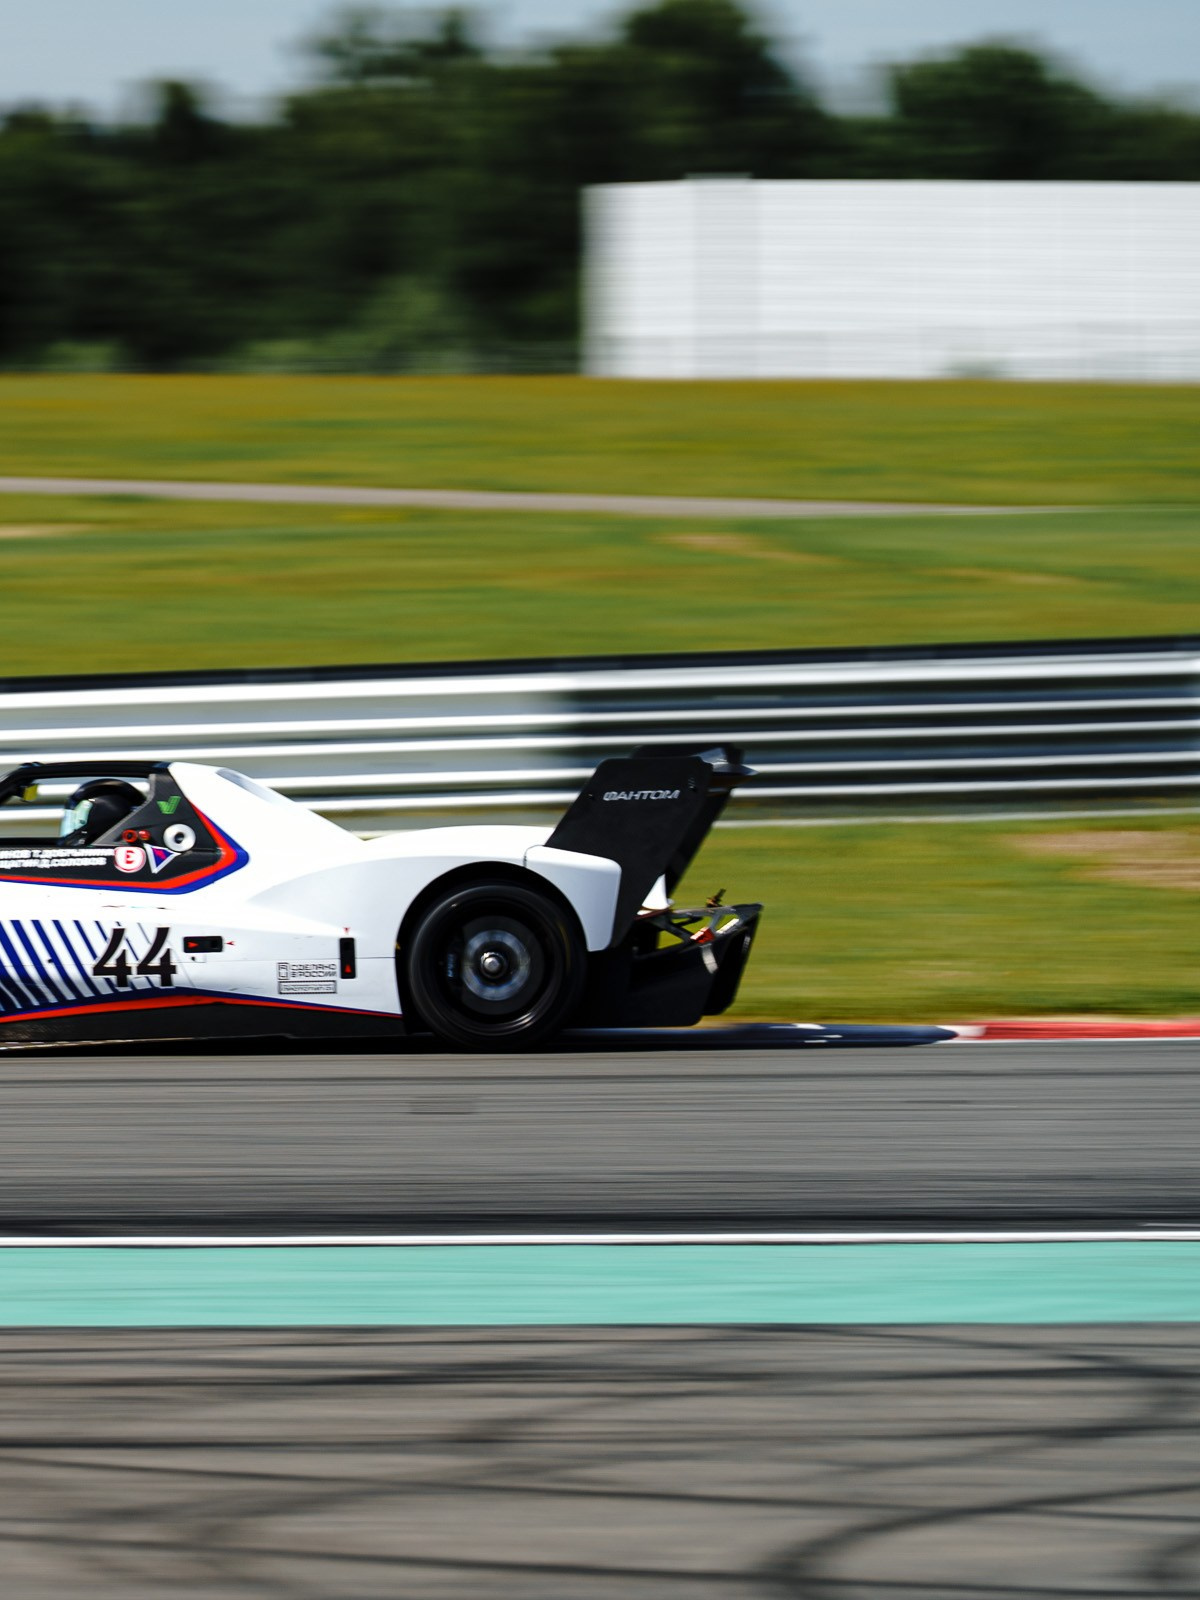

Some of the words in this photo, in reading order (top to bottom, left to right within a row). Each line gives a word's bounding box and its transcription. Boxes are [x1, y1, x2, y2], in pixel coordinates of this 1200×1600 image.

[603, 789, 680, 801] ФАНТОМ
[93, 927, 177, 987] 44
[291, 963, 337, 971] СДЕЛАНО
